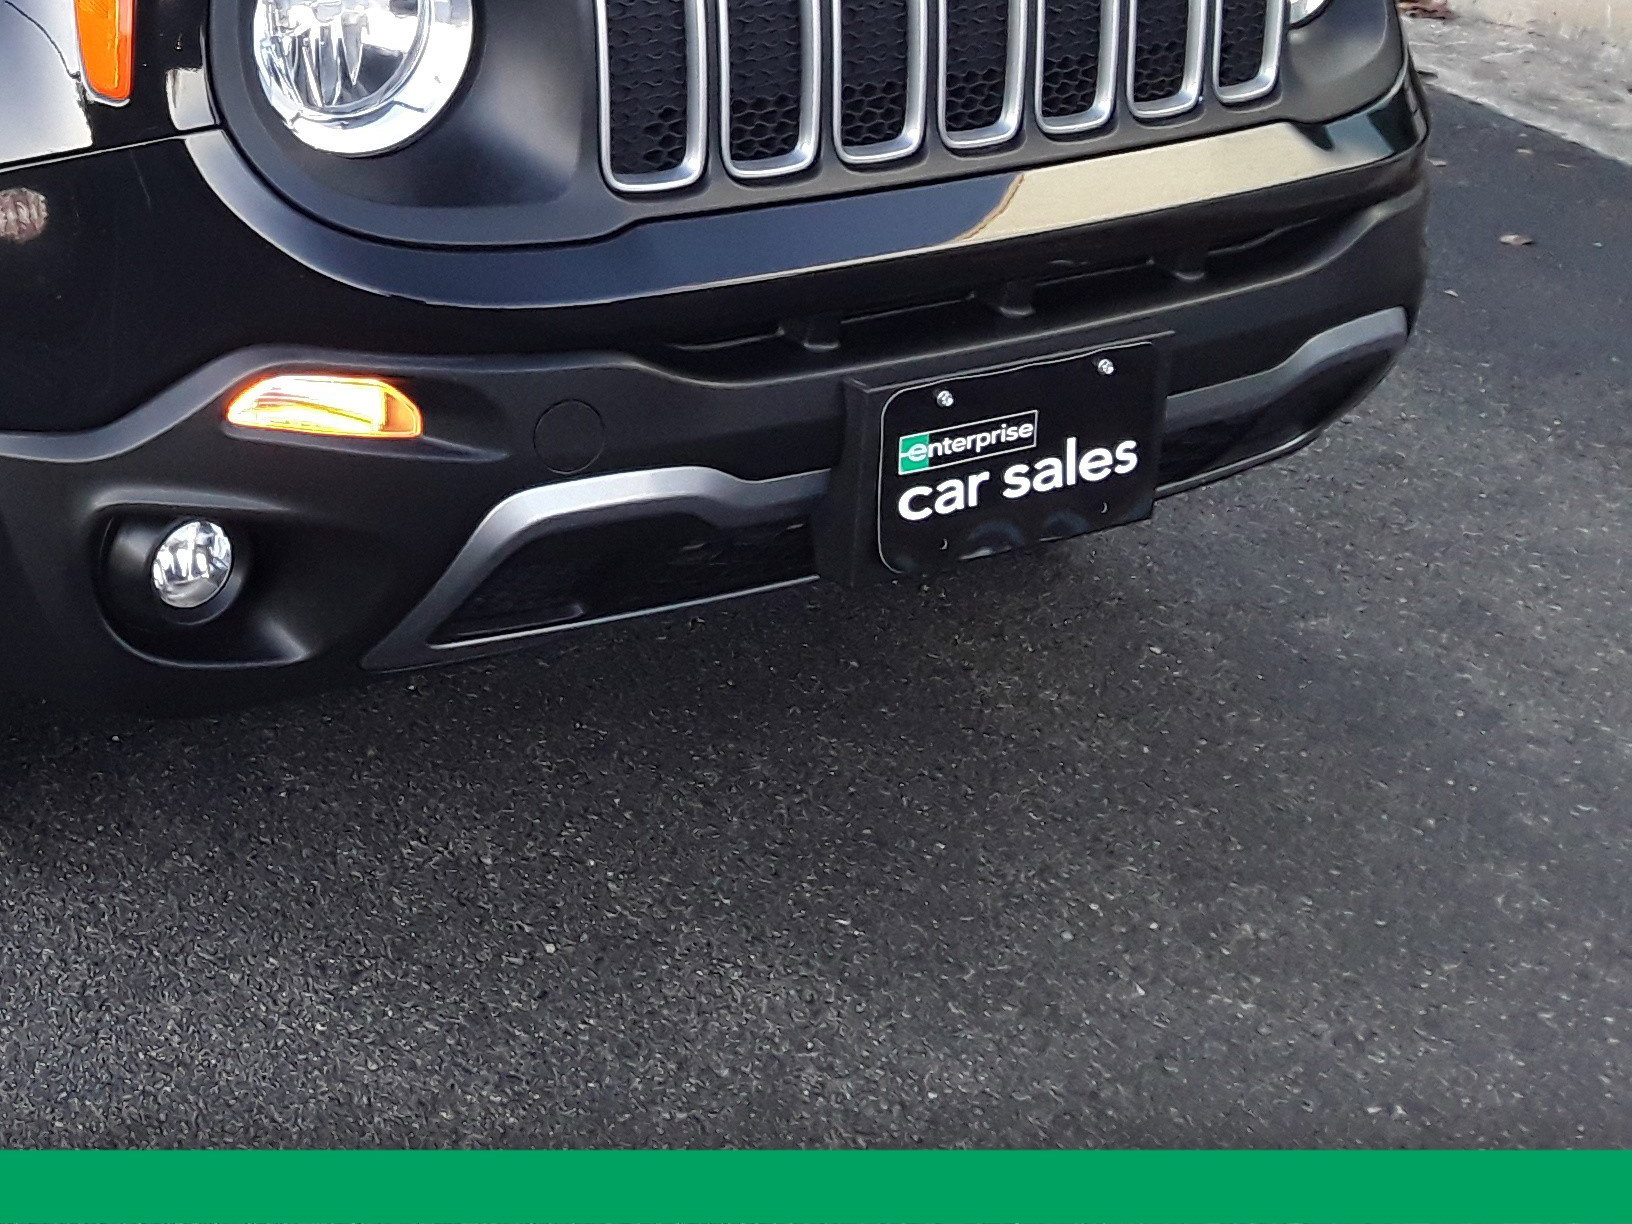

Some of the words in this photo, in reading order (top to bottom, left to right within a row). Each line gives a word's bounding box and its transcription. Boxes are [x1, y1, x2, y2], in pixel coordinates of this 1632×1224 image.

[905, 422, 1034, 463] enterprise
[897, 471, 991, 522] car
[1002, 436, 1139, 500] sales
